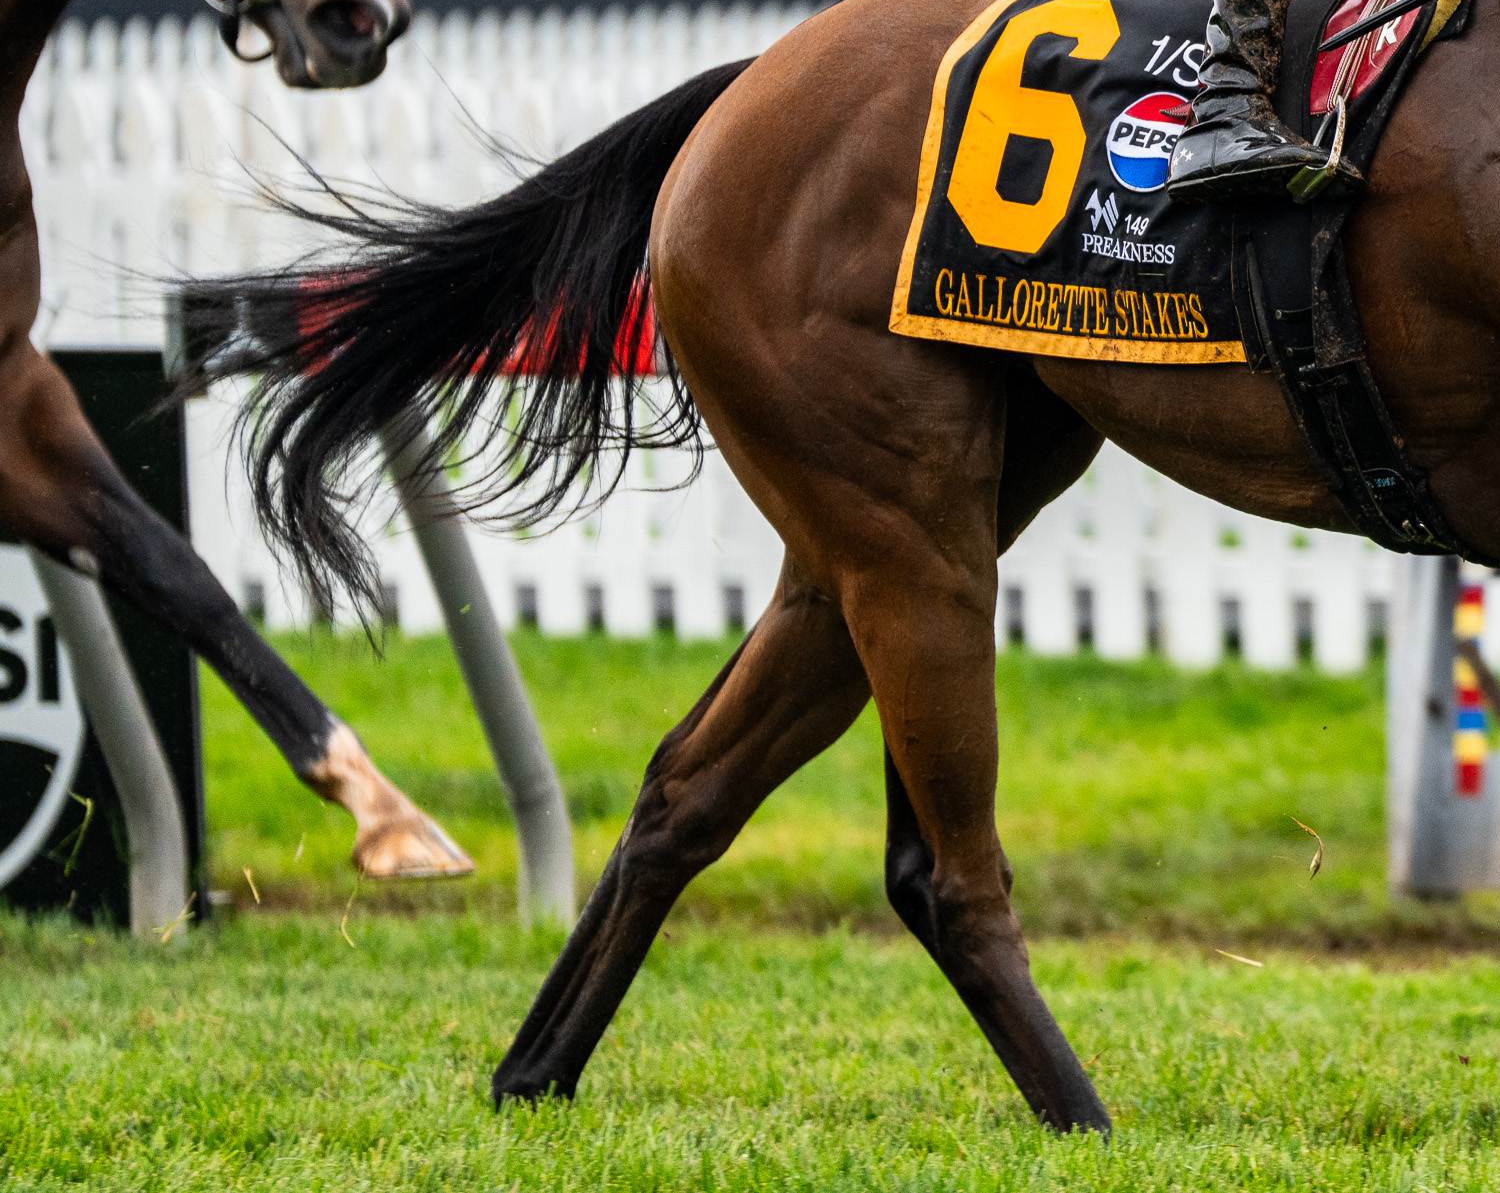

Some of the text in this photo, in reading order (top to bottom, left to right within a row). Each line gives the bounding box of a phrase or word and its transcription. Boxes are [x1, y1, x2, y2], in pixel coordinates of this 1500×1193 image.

[1112, 121, 1179, 154] PEPS
[1124, 214, 1150, 236] 149
[1082, 233, 1176, 264] PREAKNESS
[935, 268, 1209, 339] GALLORETTE STAKES
